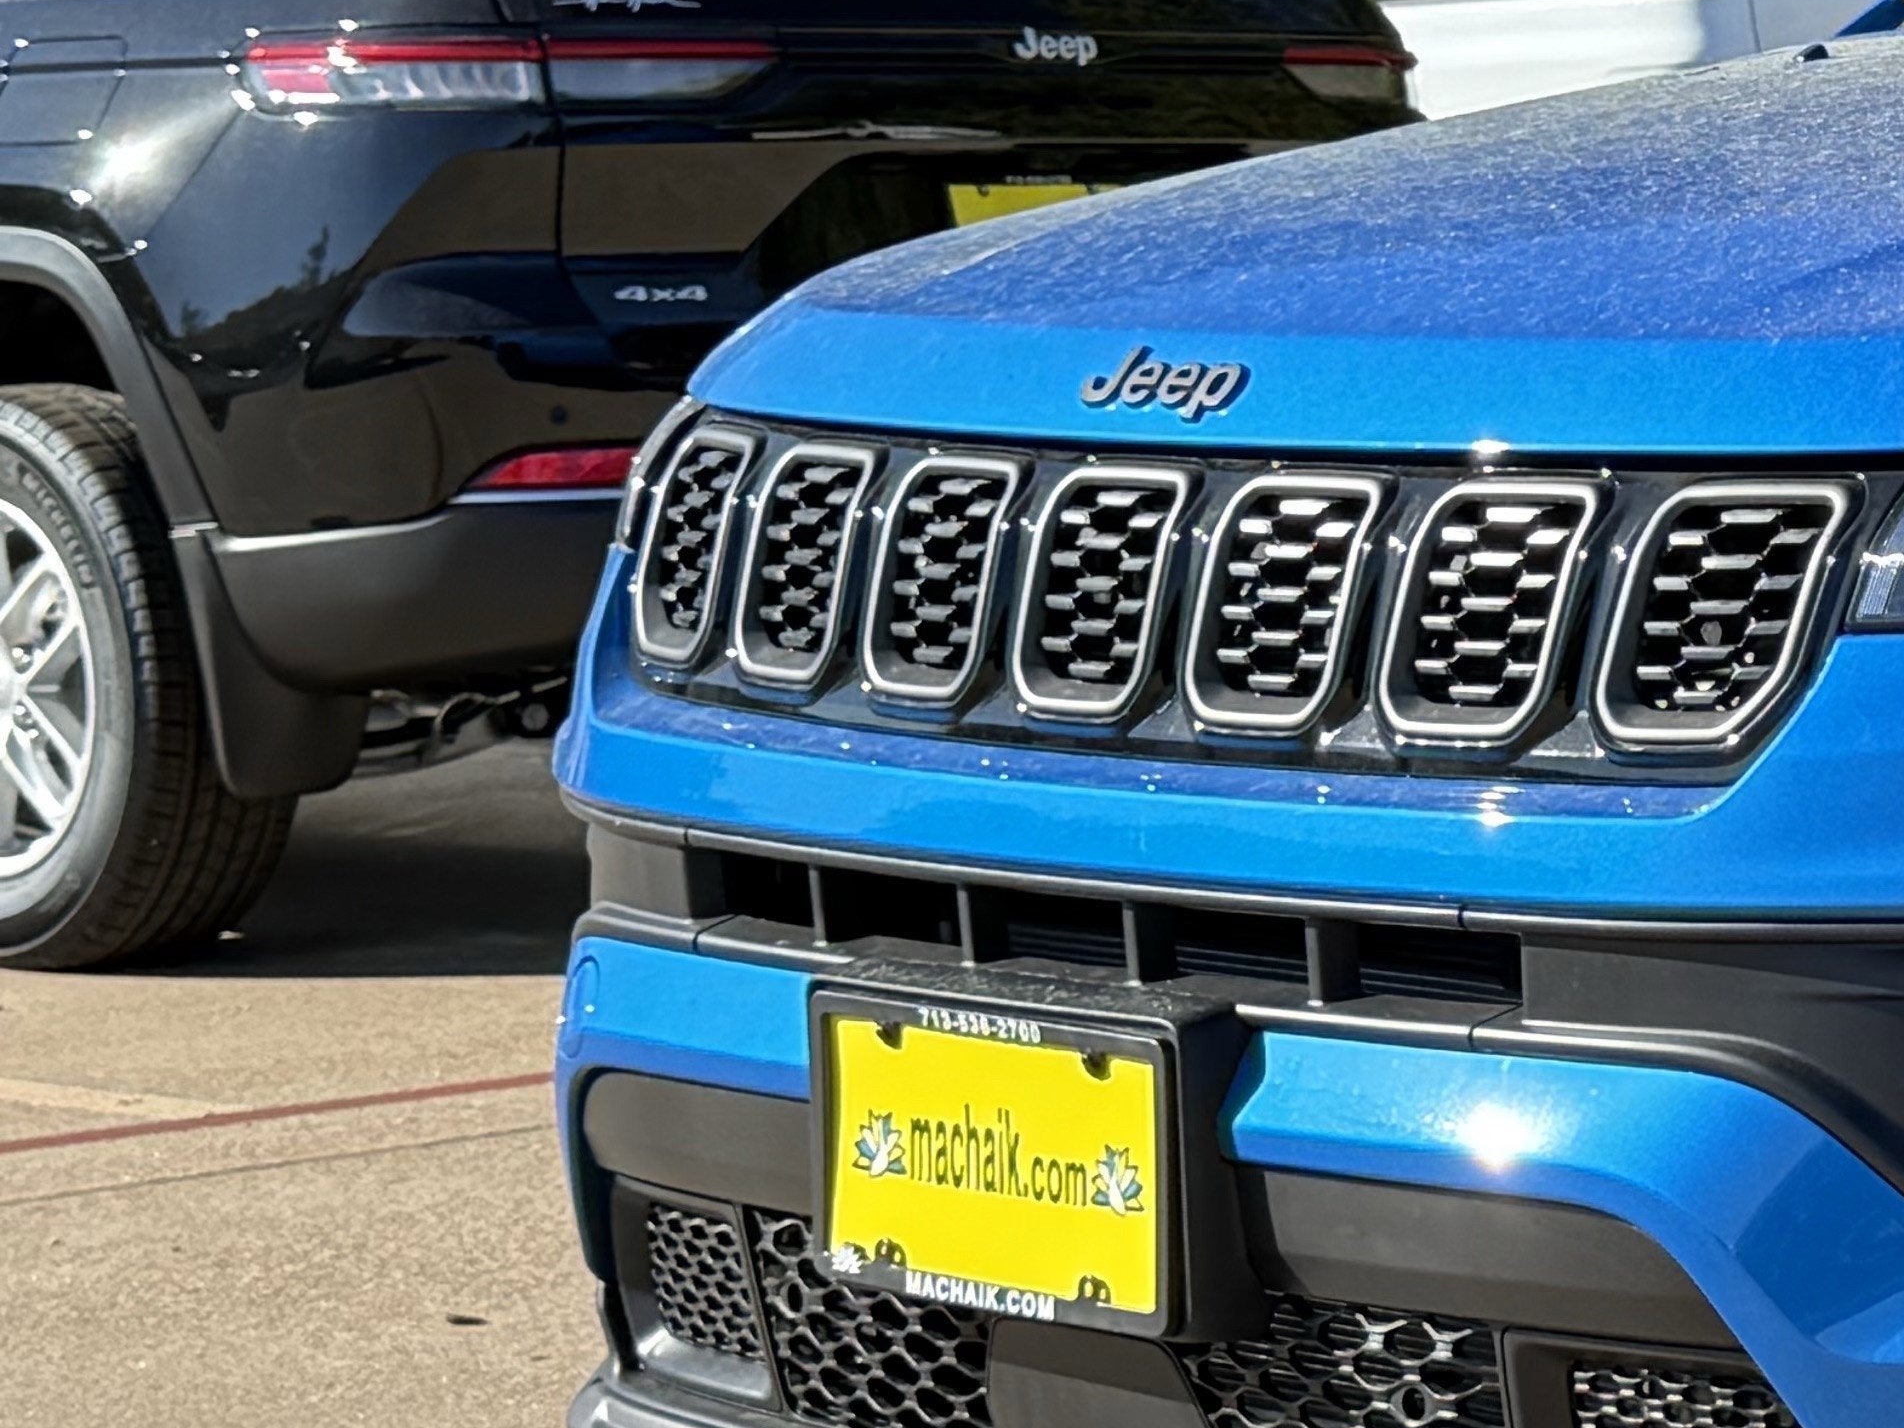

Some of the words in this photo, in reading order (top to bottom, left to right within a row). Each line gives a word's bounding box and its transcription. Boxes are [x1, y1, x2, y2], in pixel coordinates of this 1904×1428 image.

[1013, 26, 1098, 67] Jeep
[1081, 345, 1252, 424] Jeep
[909, 1103, 1088, 1207] machaik.com
[905, 1272, 1055, 1321] MACHAIK.COM
